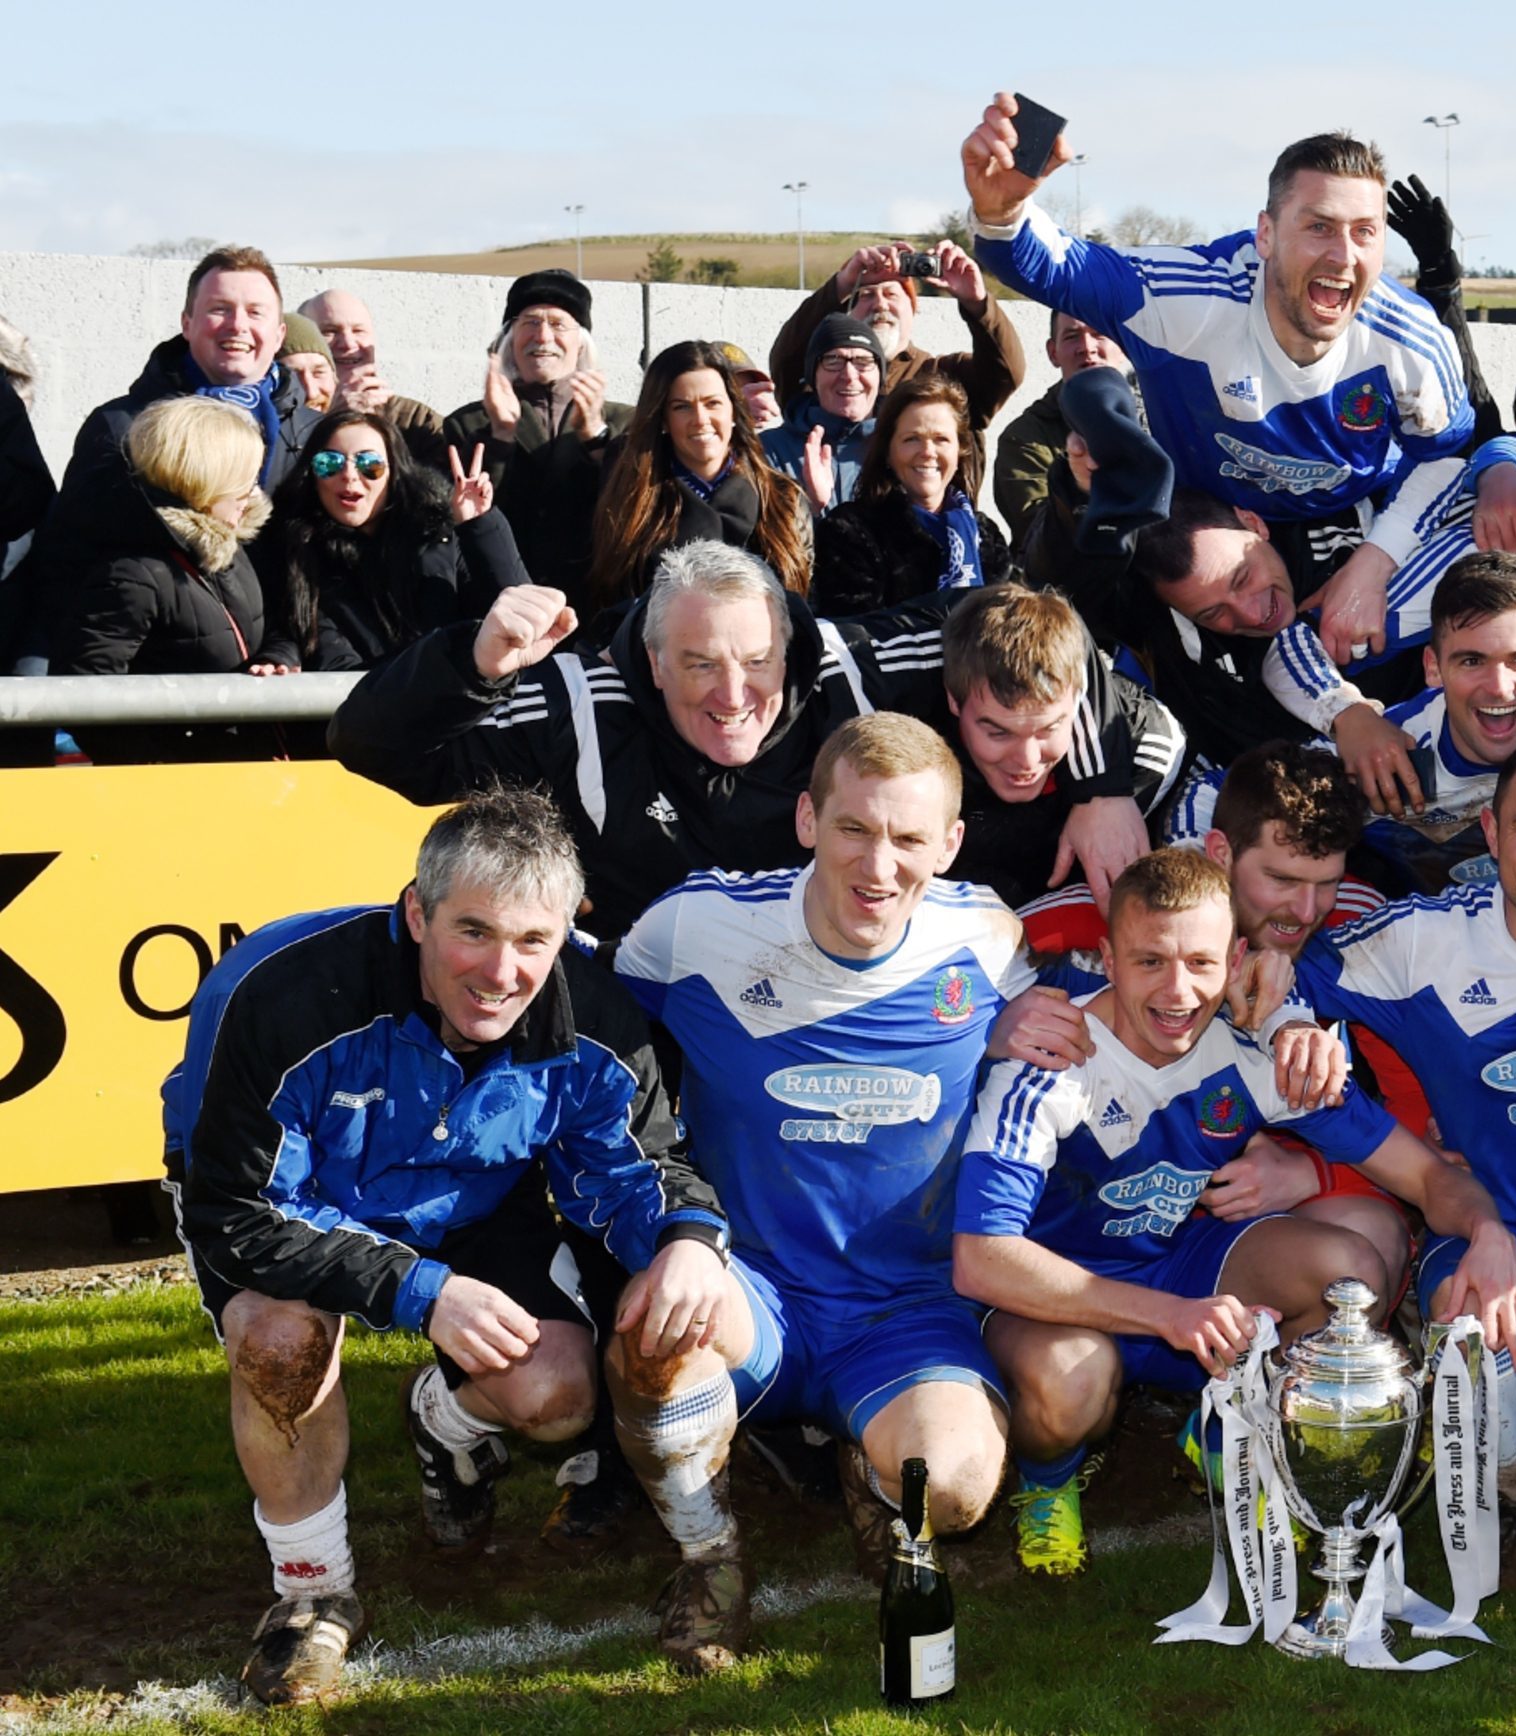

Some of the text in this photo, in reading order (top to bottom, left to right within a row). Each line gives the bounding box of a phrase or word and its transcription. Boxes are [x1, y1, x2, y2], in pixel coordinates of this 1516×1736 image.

[740, 992, 783, 1009] adidas
[1459, 994, 1497, 1005] adidas
[783, 1072, 914, 1096] RAINBOW
[842, 1103, 914, 1117] CITY
[780, 1119, 874, 1143] 878787
[1115, 1173, 1212, 1199] RAINBOW
[1153, 1199, 1196, 1216] CIT
[1234, 1435, 1252, 1503] Journal
[1442, 1375, 1467, 1552] The Press and Journal
[1236, 1503, 1250, 1532] and
[1270, 1537, 1287, 1602] Journal
